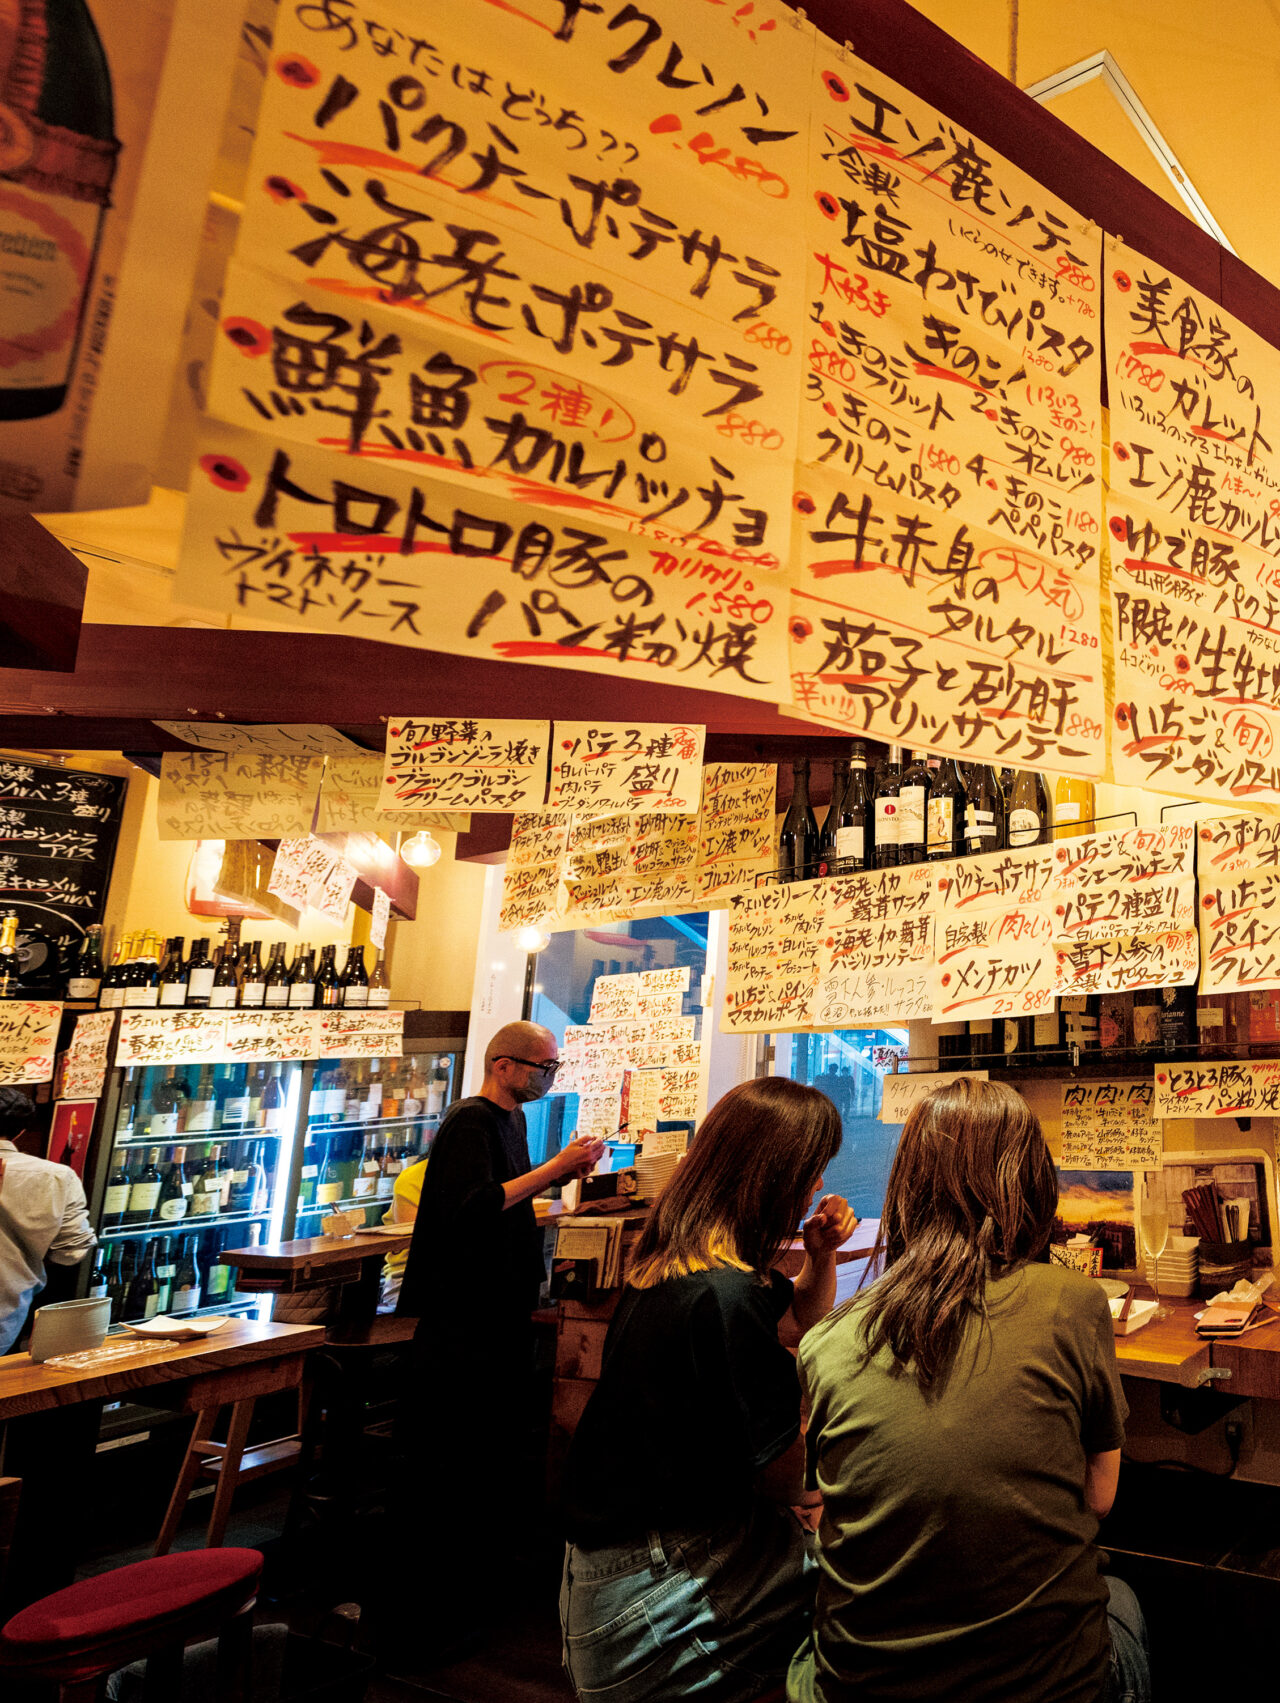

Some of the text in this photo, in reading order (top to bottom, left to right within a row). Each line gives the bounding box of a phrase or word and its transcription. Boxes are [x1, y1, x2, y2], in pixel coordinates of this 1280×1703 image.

[288, 167, 764, 417] 海老ポテサラ
[1056, 256, 1096, 292] 980
[742, 320, 793, 358] 680
[808, 338, 856, 383] 880
[716, 413, 784, 451] 880
[1164, 373, 1273, 467] ガレット
[1060, 436, 1096, 467] 980
[808, 491, 1000, 605] 牛赤身の
[1126, 514, 1241, 587] ゆで豚
[235, 572, 423, 637] トマトソース
[927, 597, 1075, 665] タルタル
[808, 616, 1080, 736] 茄子と砂肝
[1064, 712, 1102, 741] 880
[1169, 825, 1193, 848] 980
[943, 856, 1054, 908] パクチーポテサラ
[1018, 889, 1042, 904] 680
[950, 957, 1042, 999] メンチカツ
[1021, 990, 1051, 1011] 880
[1168, 1064, 1253, 1093] とろとろ豚の
